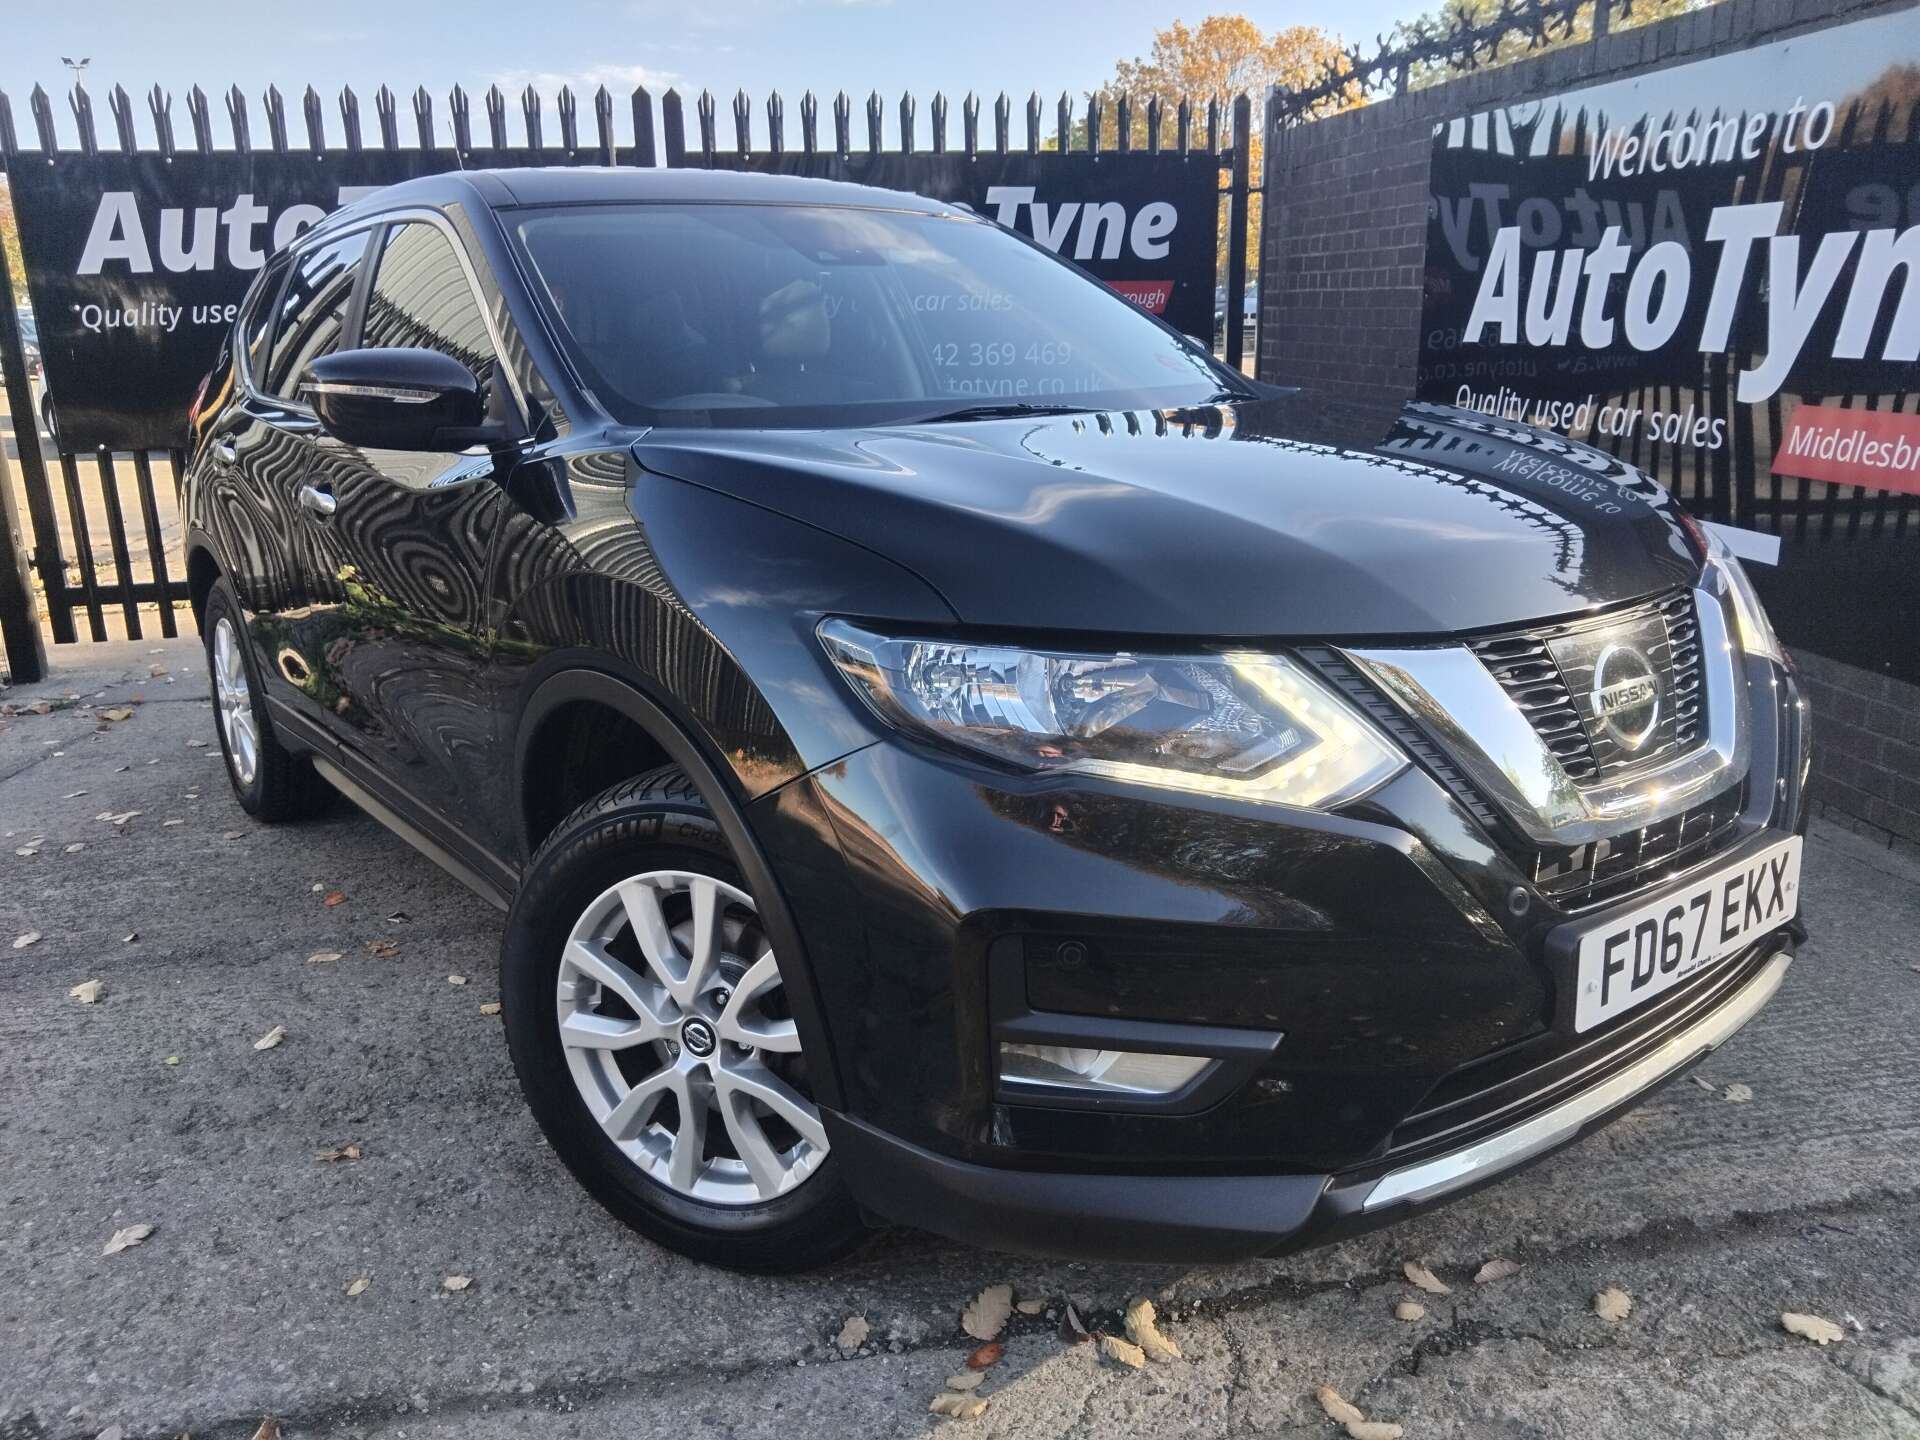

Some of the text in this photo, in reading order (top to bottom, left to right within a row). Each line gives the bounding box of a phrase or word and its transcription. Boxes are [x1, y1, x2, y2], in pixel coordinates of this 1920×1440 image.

[1588, 95, 1836, 182] Welcome to
[76, 186, 393, 275] Auto
[81, 301, 182, 333] Quality
[914, 288, 1014, 312] car sales
[968, 342, 1016, 366] 369
[1024, 341, 1072, 366] 469
[1535, 394, 1593, 432] used
[1598, 405, 1642, 438] car
[1647, 403, 1726, 450] sales
[1600, 680, 1659, 711] NISSAN
[1601, 852, 1789, 1008] FD67 EKX
